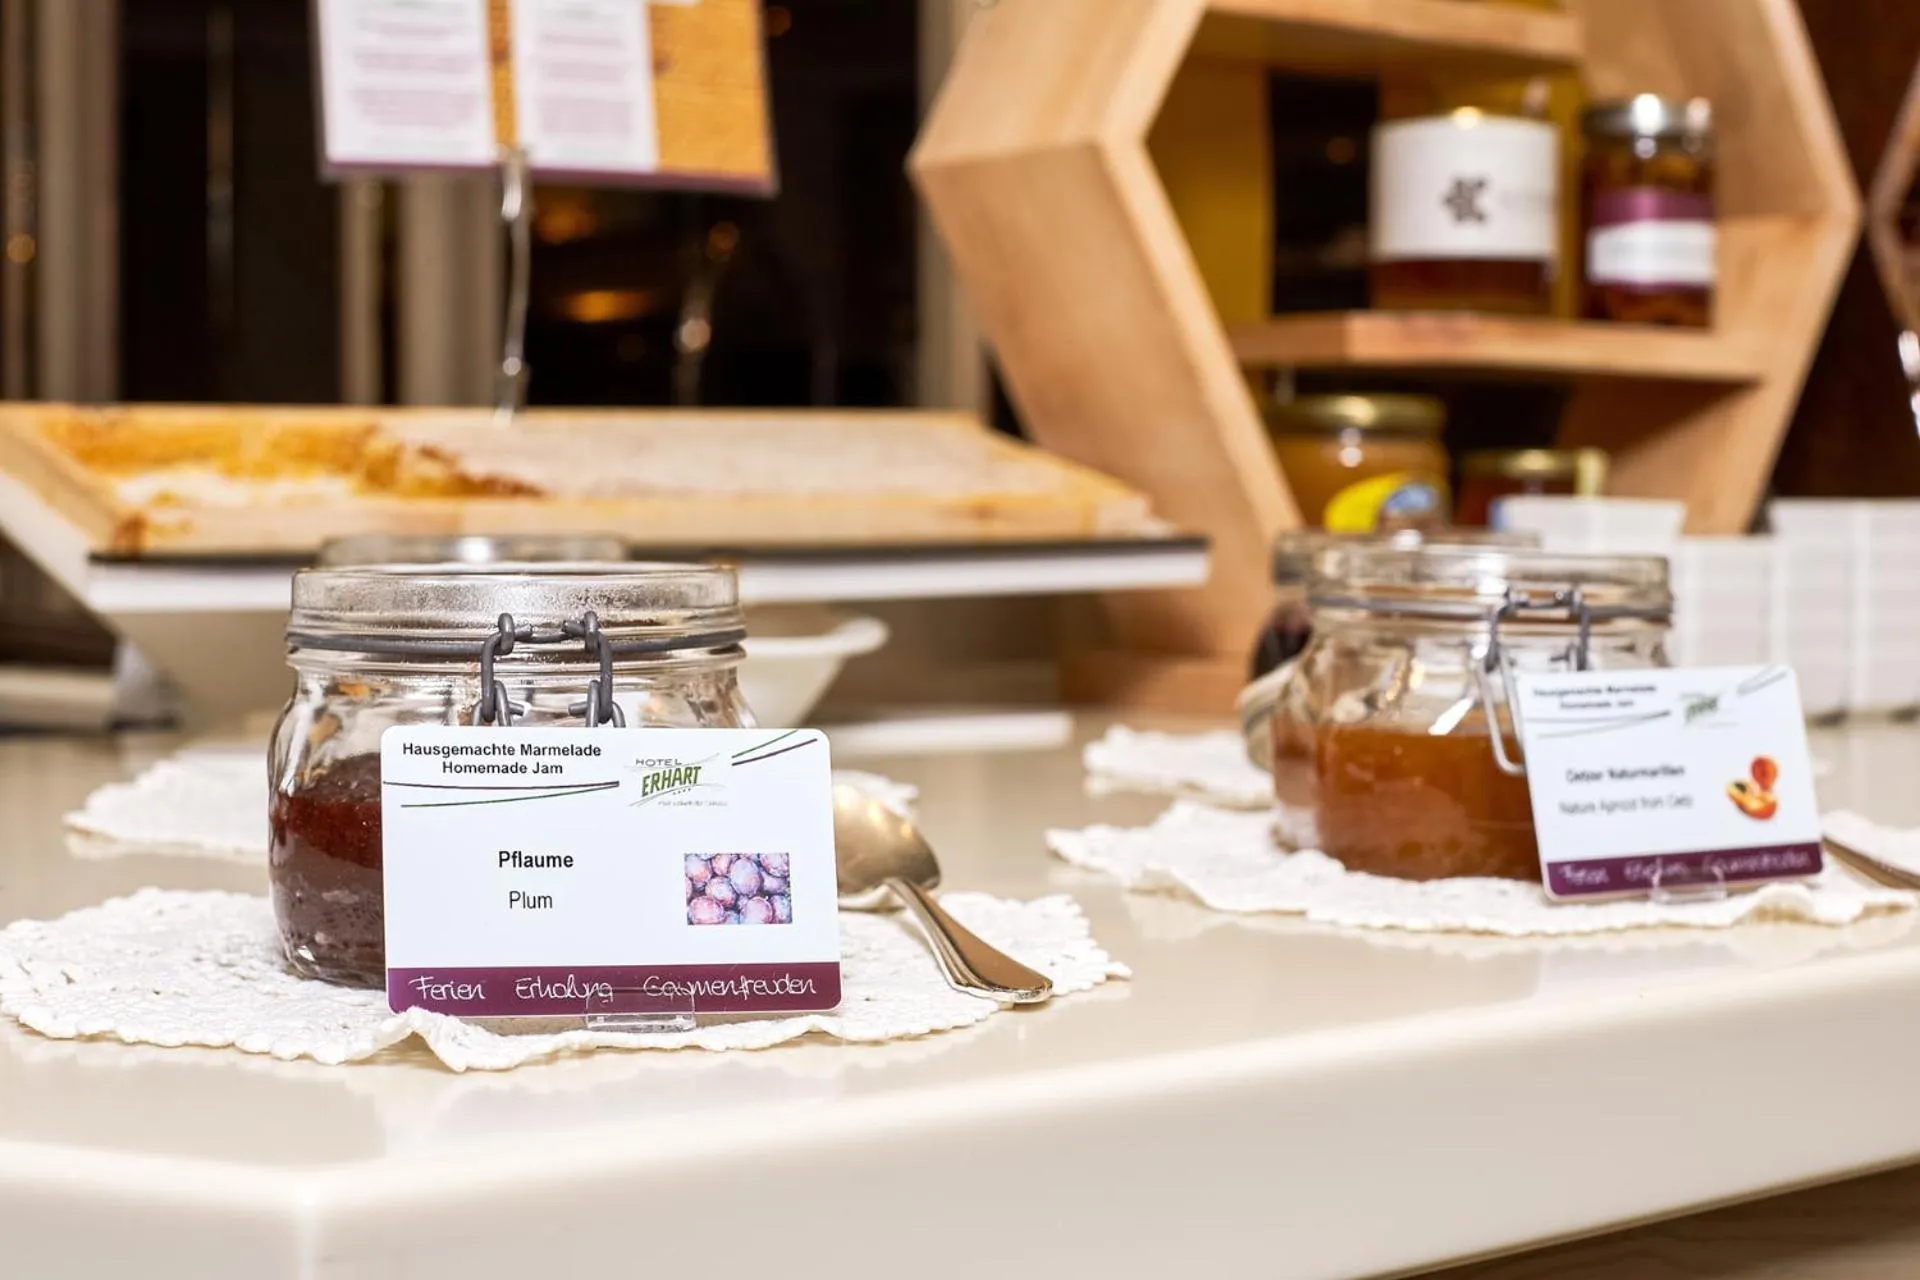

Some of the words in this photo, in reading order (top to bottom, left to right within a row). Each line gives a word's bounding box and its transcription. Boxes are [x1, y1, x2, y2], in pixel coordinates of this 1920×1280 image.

[402, 742, 515, 758] Hausgemachte
[520, 743, 602, 756] Marmelade
[442, 761, 528, 774] Homemade
[532, 761, 563, 774] Jam
[635, 758, 683, 767] HOTEL
[641, 765, 702, 798] ERHART
[498, 850, 574, 869] Pflaume
[508, 890, 553, 910] Plum
[408, 975, 486, 1002] Ferien
[514, 973, 614, 1009] Erholung
[642, 972, 817, 1002] Gaumenfreuden
